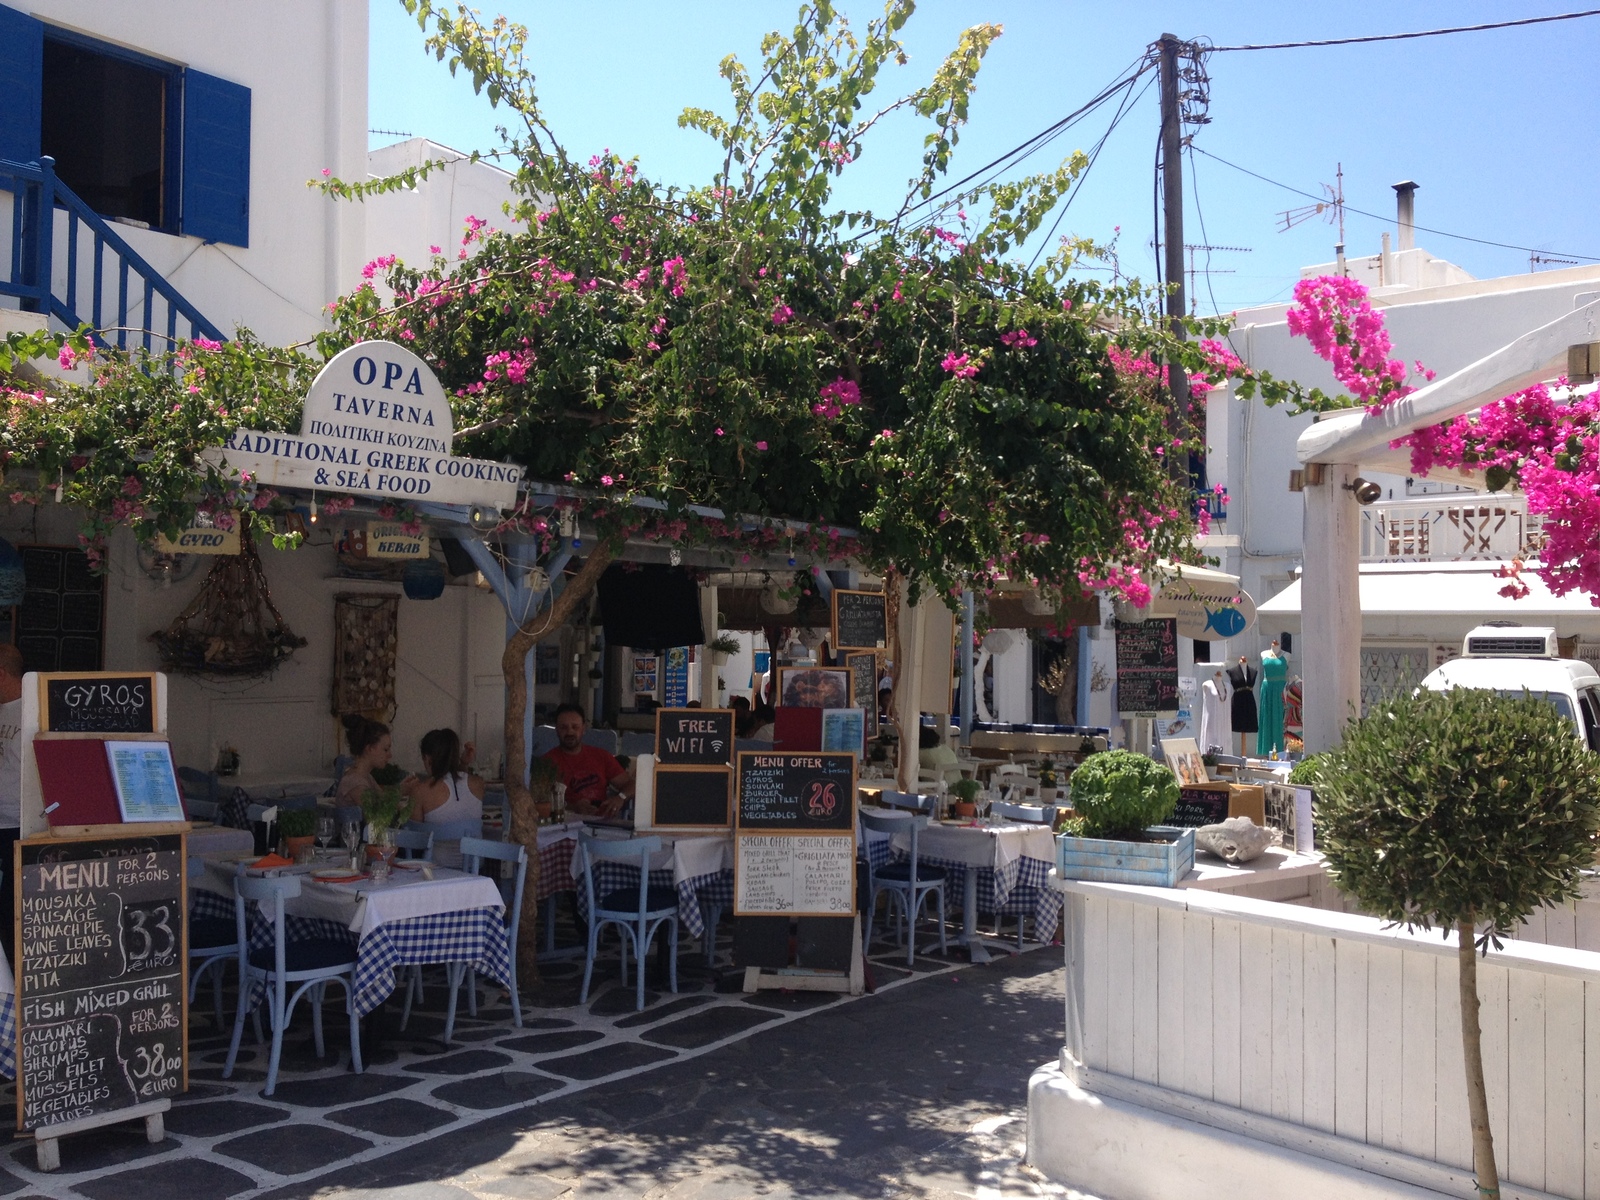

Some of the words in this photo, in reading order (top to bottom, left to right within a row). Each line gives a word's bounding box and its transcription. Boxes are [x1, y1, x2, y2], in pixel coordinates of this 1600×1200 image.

[352, 356, 425, 396] OPA
[332, 393, 435, 427] TAVERNA
[309, 419, 385, 443] ΠΟΛΙΤΙΚΗ
[386, 432, 447, 454] ΚΟΥΖΙΝΑ
[222, 433, 361, 466] RADITIONAL
[367, 450, 431, 474] GREEK
[434, 458, 519, 484] COOKING
[313, 468, 329, 486] &
[335, 470, 371, 491] SEA
[377, 474, 431, 495] FOOD
[179, 533, 224, 547] GYRO
[378, 542, 420, 554] KEBAB
[855, 595, 862, 604] 2
[64, 685, 144, 707] GYROS
[679, 719, 717, 733] FREE
[753, 756, 784, 768] MENU
[790, 757, 822, 768] OFFER
[809, 782, 836, 808] 26
[744, 811, 797, 819] VEGETABLES
[1185, 805, 1205, 815] PORK
[741, 837, 768, 848] SPECIAL
[770, 837, 792, 848] OFFER
[798, 837, 824, 848] SPECIAL
[37, 862, 109, 892] MENU
[118, 858, 141, 870] FOR
[145, 851, 157, 869] 2
[116, 869, 170, 885] PERSONS
[22, 892, 97, 913] MOUSAKA
[23, 907, 98, 925] SAUSAGE
[23, 923, 80, 940] SPINACH
[83, 920, 104, 934] PIE
[129, 905, 175, 960] 33
[23, 939, 58, 956] WINE
[66, 934, 112, 951] LEAVES
[22, 952, 87, 971] TZATZIKI
[24, 970, 60, 992] PITA
[131, 1008, 157, 1022] FOR
[161, 1002, 173, 1019] 2
[22, 1021, 91, 1046] CALAMARI
[129, 1016, 180, 1035] PERSONS
[23, 1048, 89, 1072] SHRIMPS
[24, 1067, 56, 1087] FISH
[65, 1057, 105, 1078] FILET
[25, 1074, 98, 1101] MUSSELS
[24, 1086, 110, 1117] VEGETABLES
